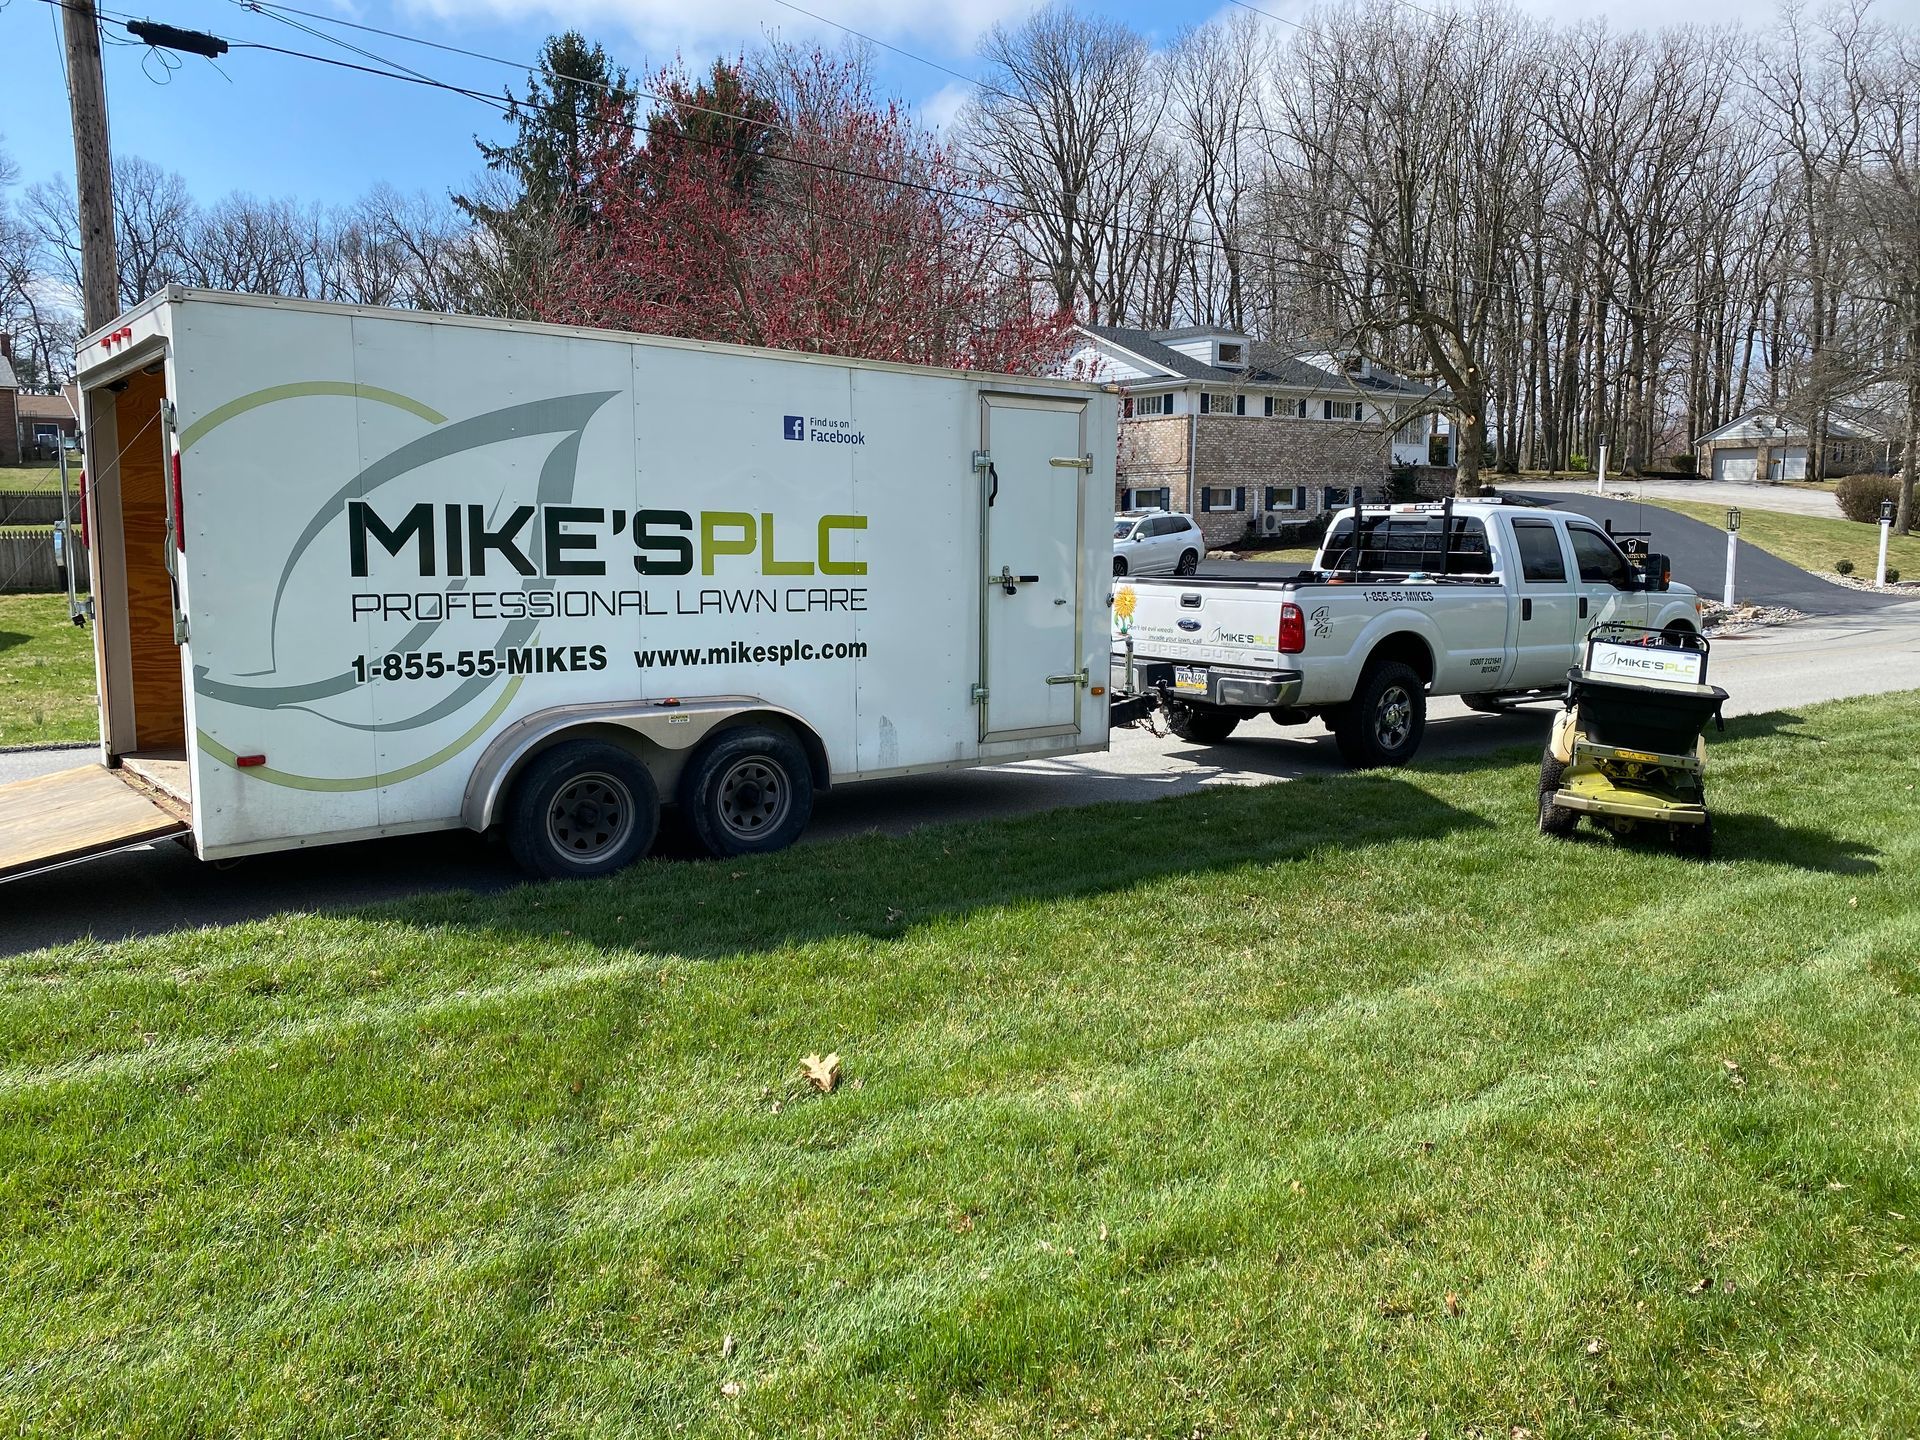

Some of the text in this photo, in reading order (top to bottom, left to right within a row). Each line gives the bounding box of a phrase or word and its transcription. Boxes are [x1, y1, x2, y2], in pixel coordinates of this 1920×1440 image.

[810, 417, 850, 429] Find us on
[811, 429, 865, 445] Facebook
[352, 588, 867, 622] PROFESSIONAL LAWN CARE
[1363, 591, 1434, 602] 1-855-55-MIKES
[352, 639, 867, 682] 1-855-55-MIKES www.mikesplc.com
[1138, 642, 1191, 657] SUPER
[1200, 646, 1246, 662] DUTY
